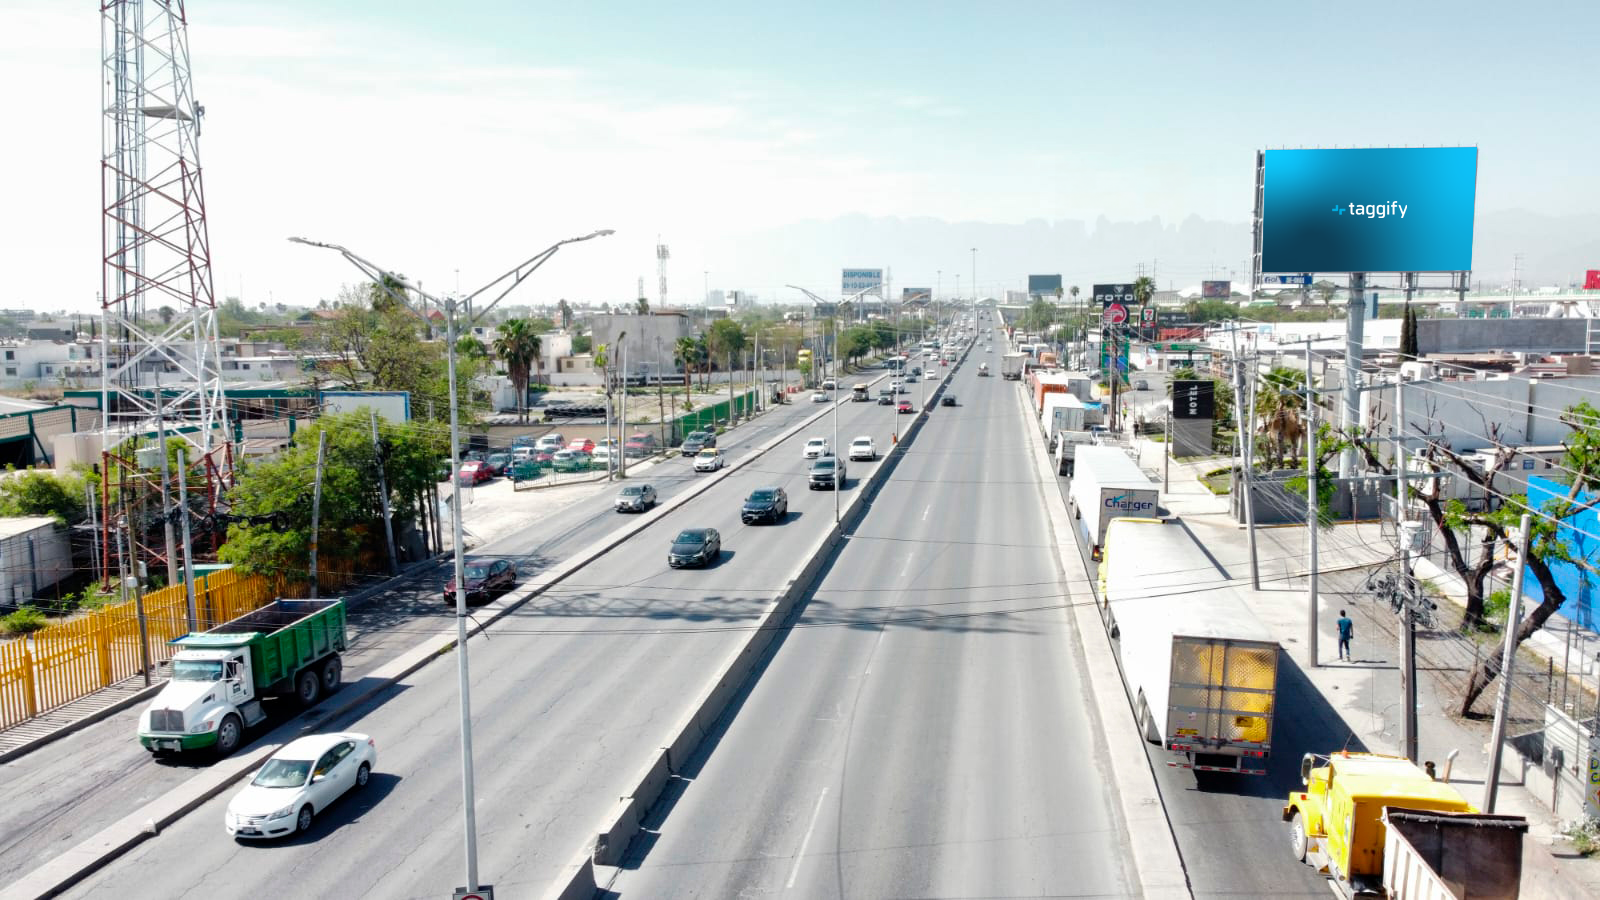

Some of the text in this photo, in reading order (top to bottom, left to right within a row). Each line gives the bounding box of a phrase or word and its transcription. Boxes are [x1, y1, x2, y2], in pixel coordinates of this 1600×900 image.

[1348, 200, 1408, 219] taggify
[1189, 384, 1198, 415] MOTEL
[1105, 496, 1153, 511] Charger
